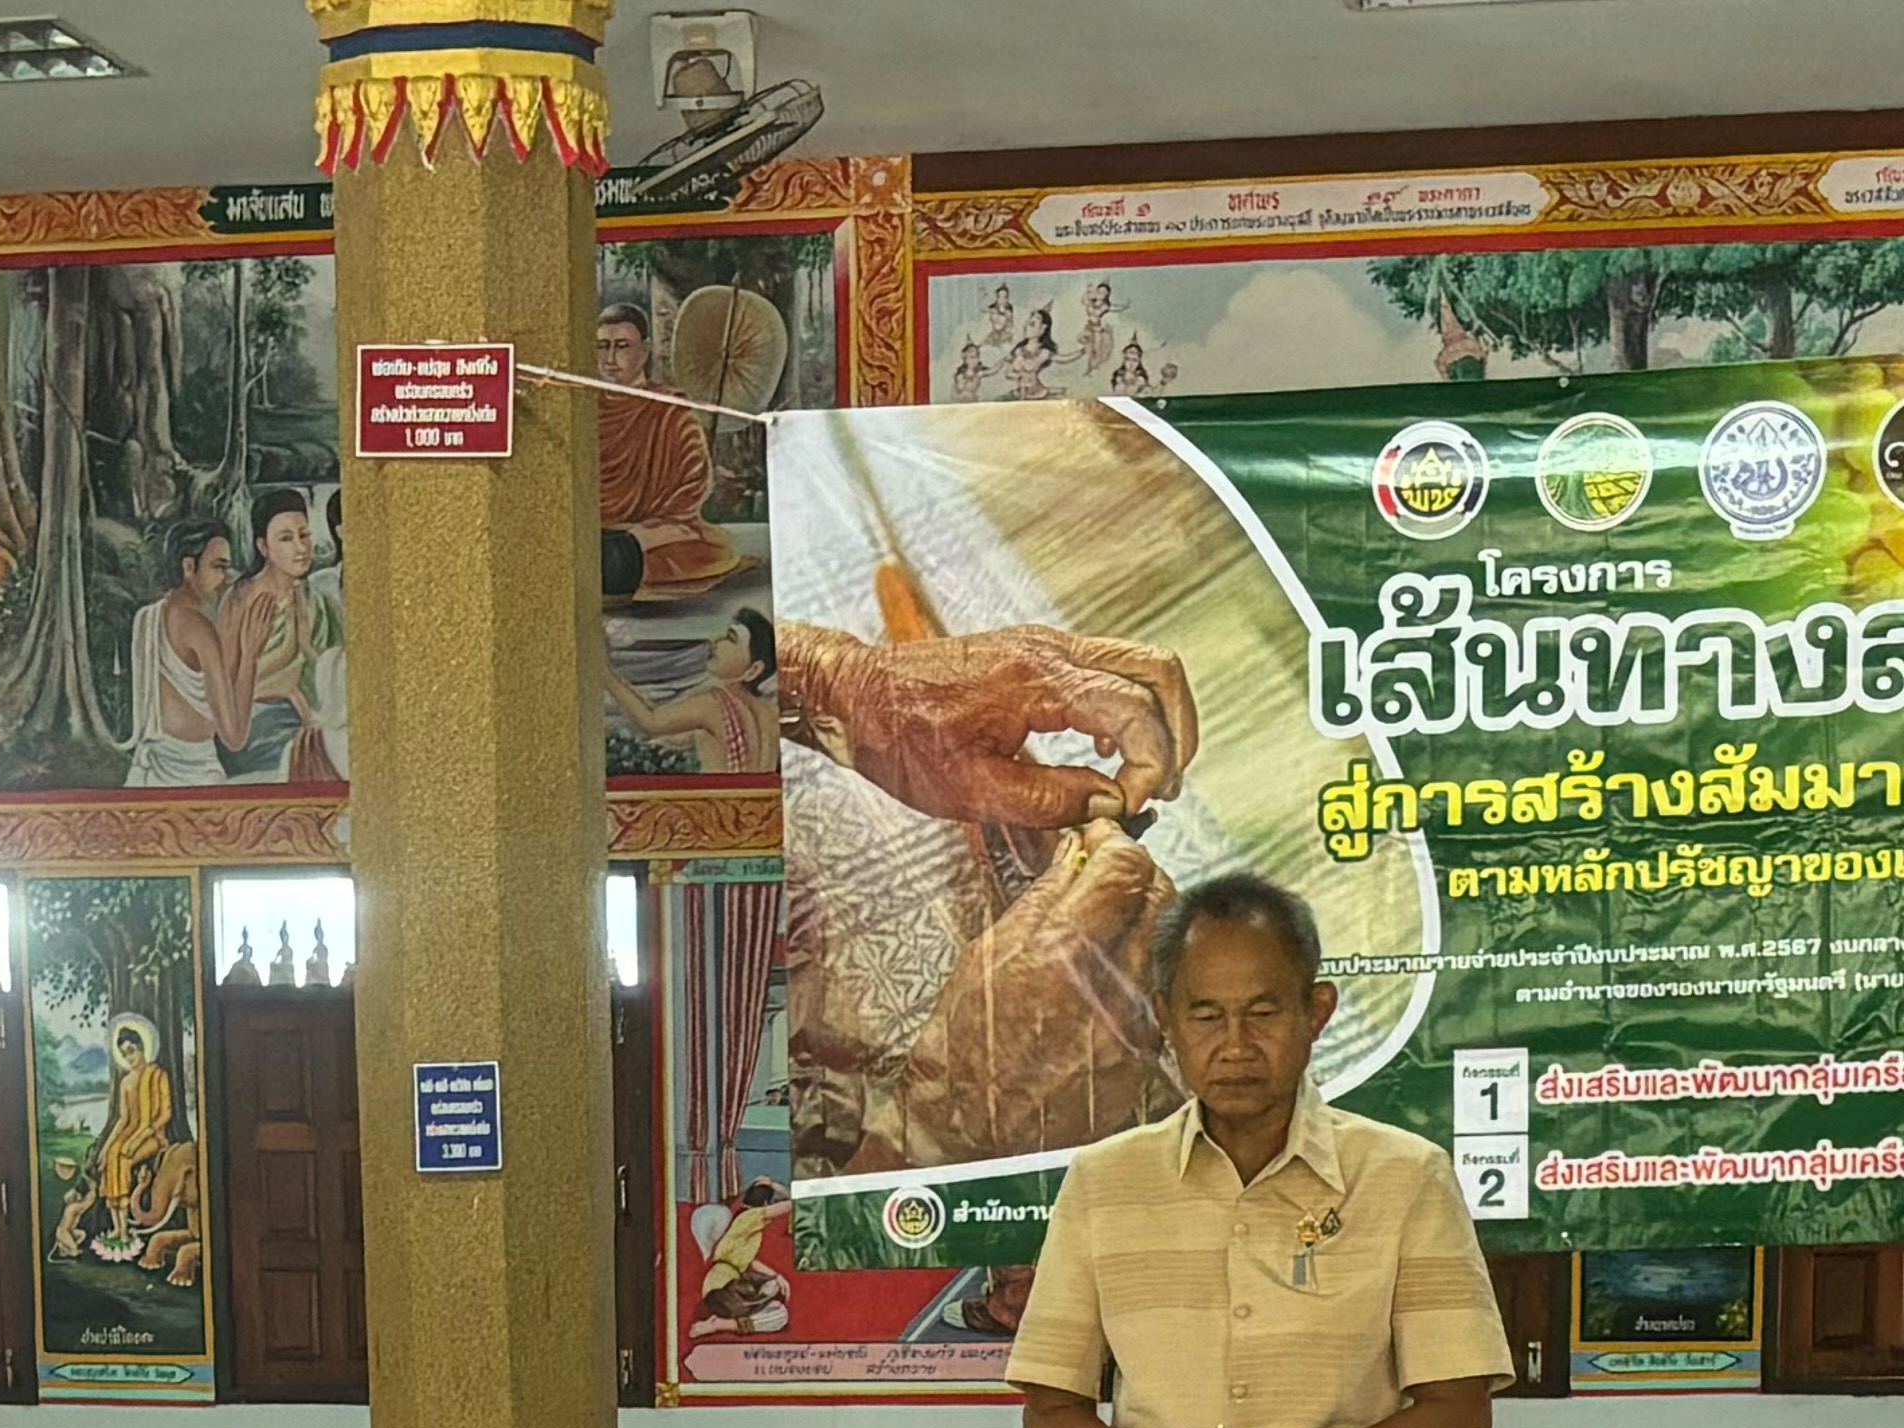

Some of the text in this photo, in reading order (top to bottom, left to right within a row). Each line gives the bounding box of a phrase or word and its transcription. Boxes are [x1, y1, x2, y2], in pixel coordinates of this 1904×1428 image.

[1477, 549, 1672, 598] โครงการ
[1719, 937, 1822, 959] พ.ศ.2567
[1516, 967, 1847, 1003] ตามอำนาจของรองนายกรัฐมนตรี
[1480, 1081, 1499, 1121] 1
[1477, 1168, 1505, 1208] 2
